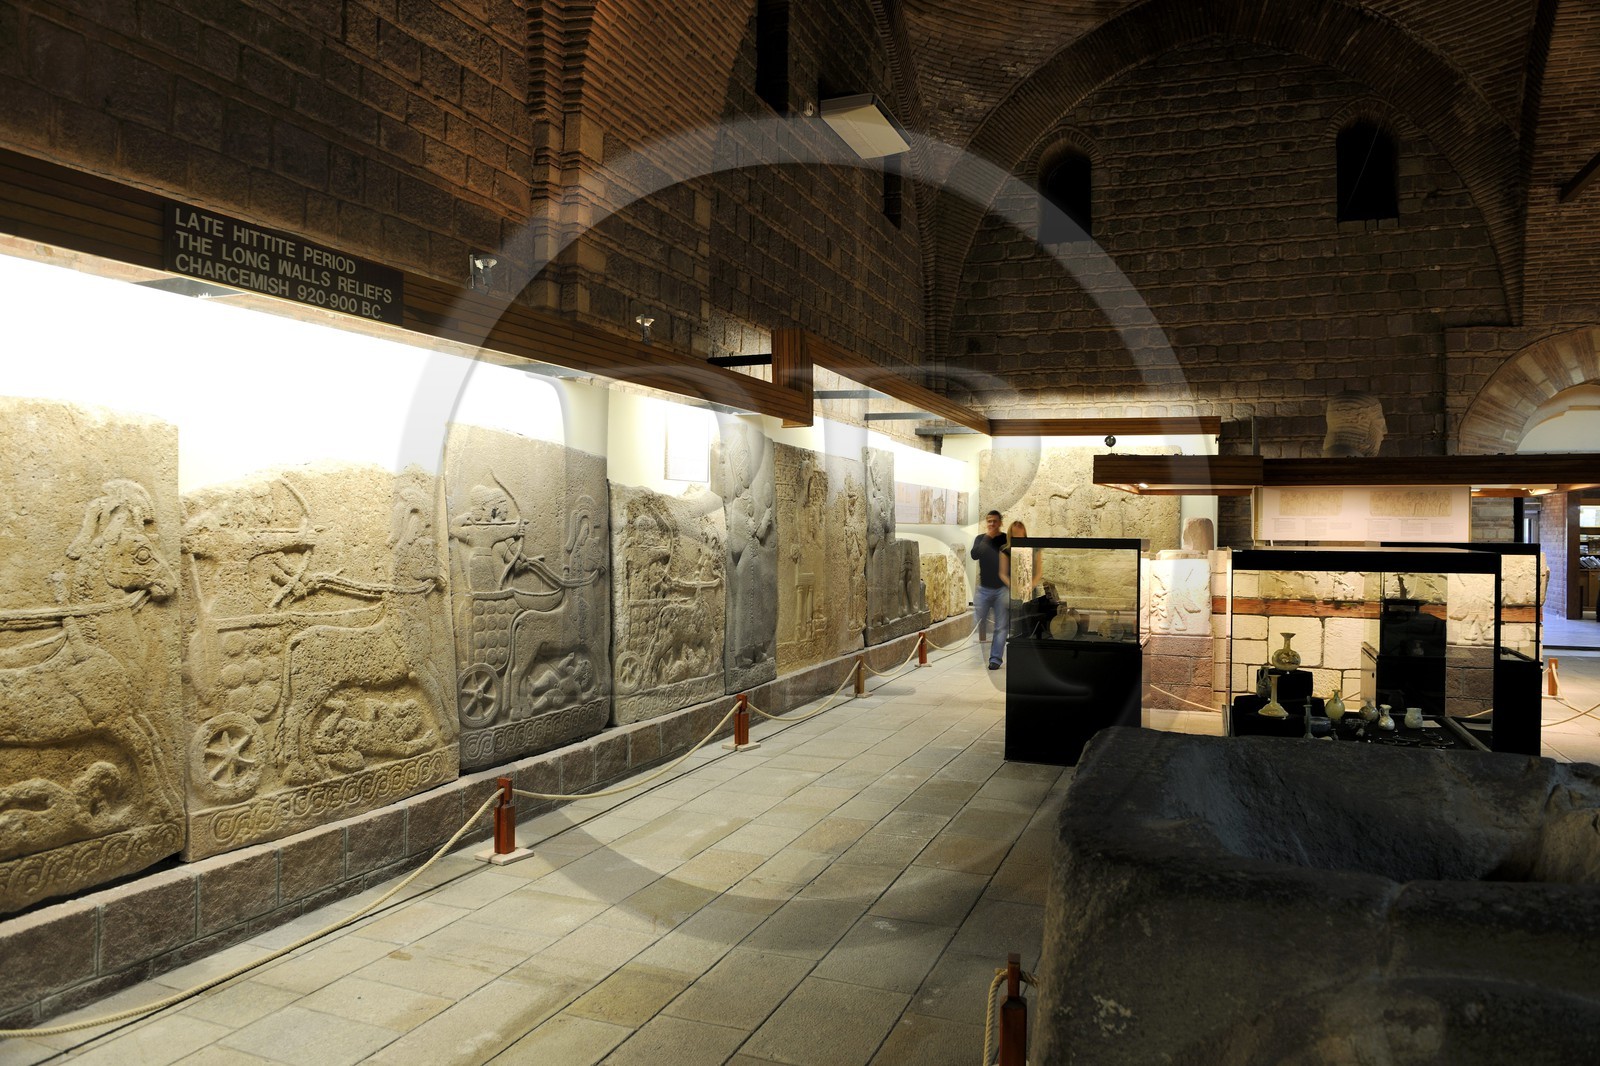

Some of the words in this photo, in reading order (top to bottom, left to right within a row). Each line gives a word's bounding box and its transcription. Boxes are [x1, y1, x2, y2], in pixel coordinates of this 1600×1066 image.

[175, 208, 224, 238] LATE
[233, 225, 296, 258] HITTITE
[303, 246, 356, 275] PERIOD
[175, 230, 213, 256] THE
[222, 243, 270, 272] LONG
[278, 260, 331, 288] WALLS
[337, 278, 392, 304] RELIEFS
[175, 253, 289, 297] CHARCEMISH
[297, 284, 357, 313] 920-900
